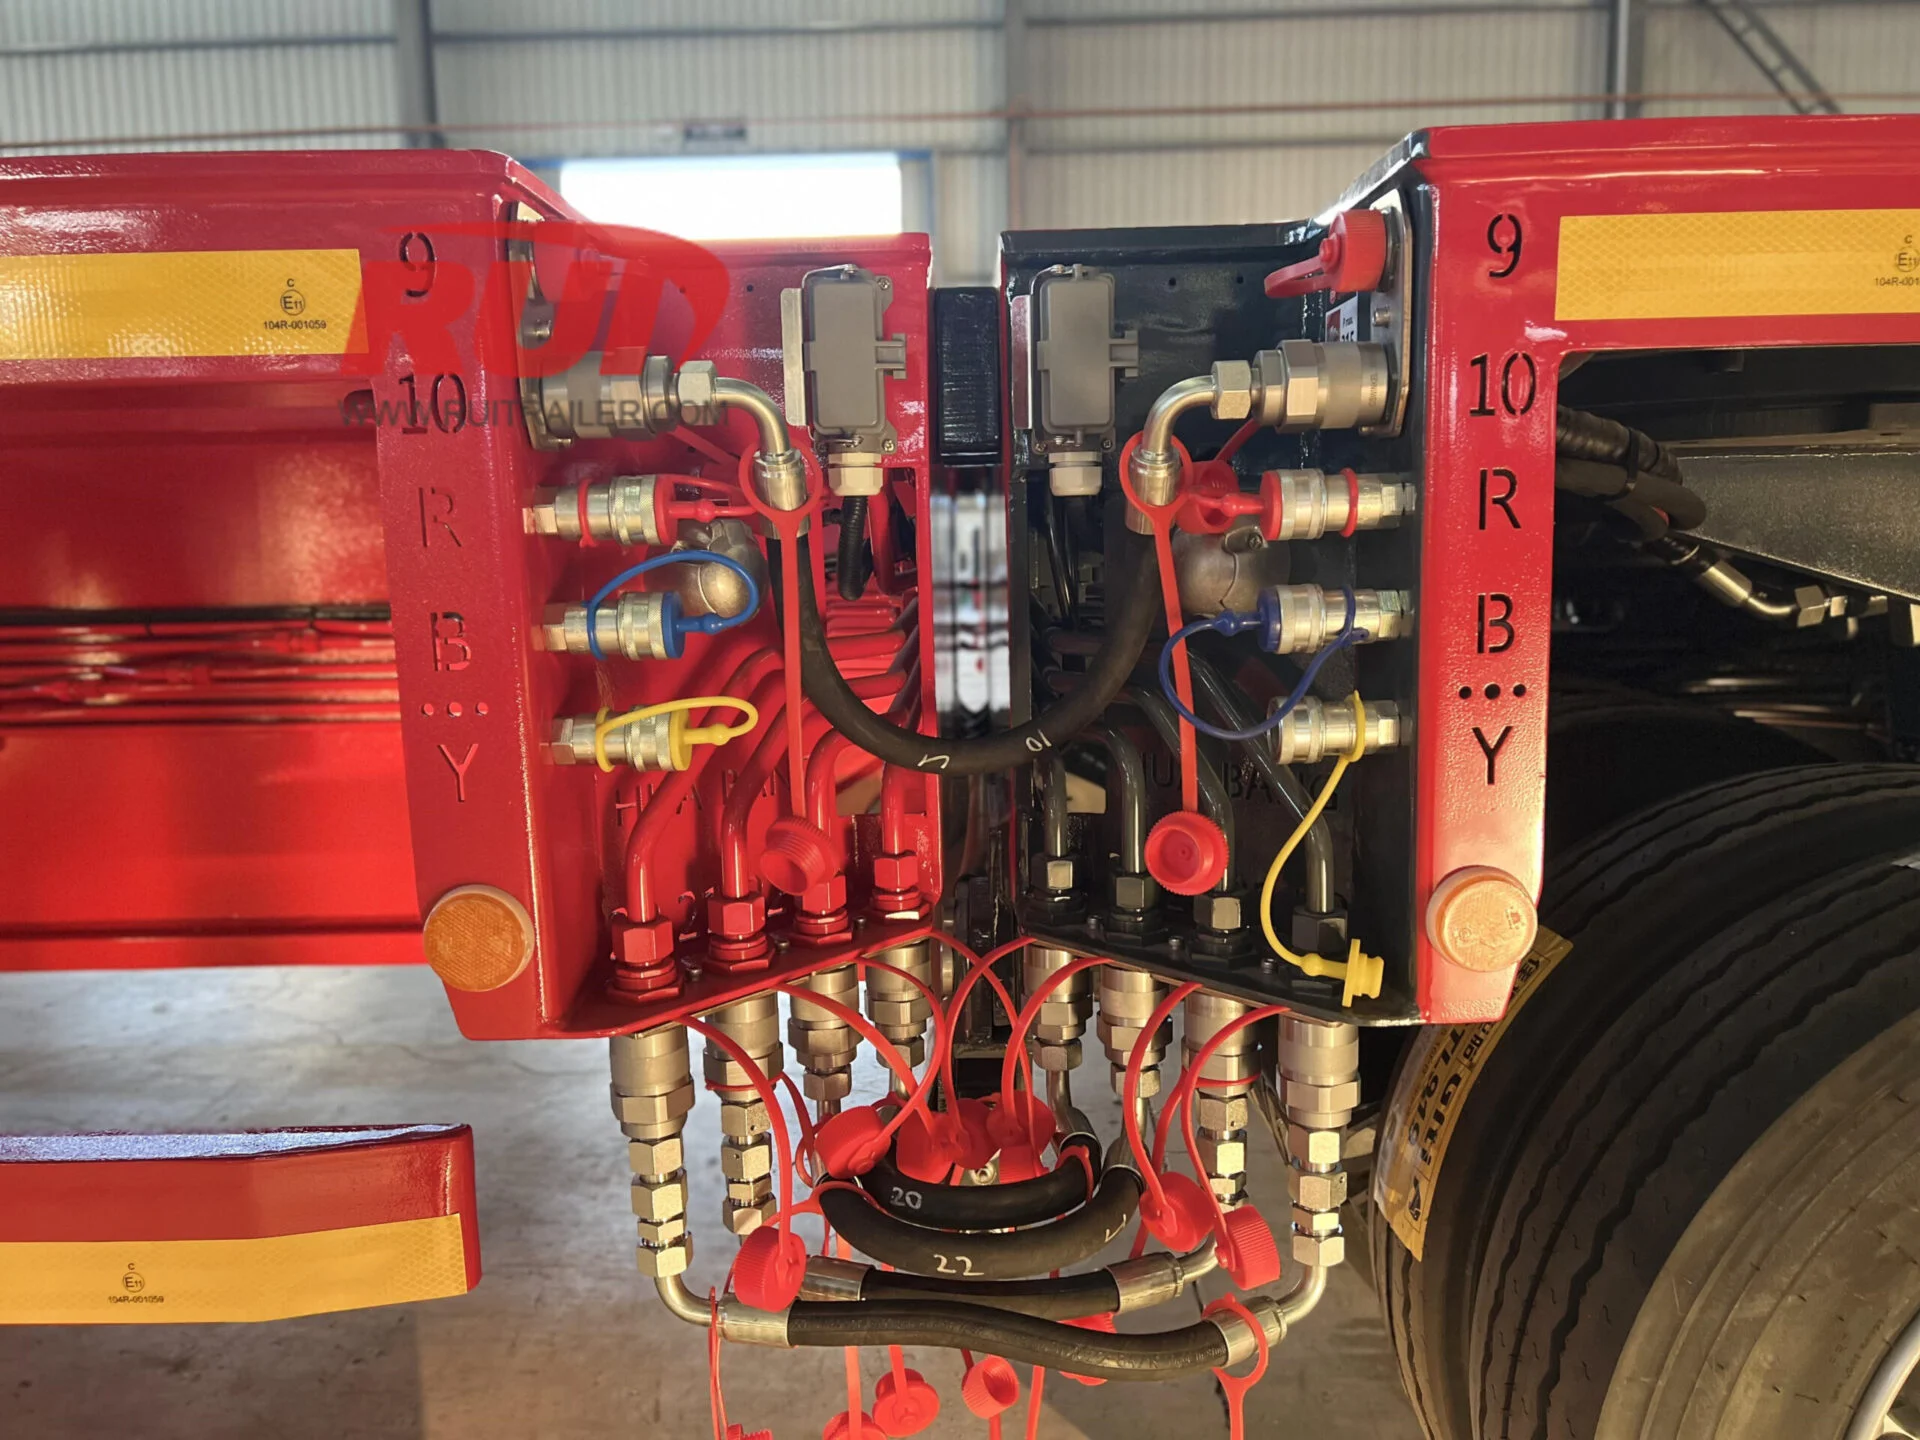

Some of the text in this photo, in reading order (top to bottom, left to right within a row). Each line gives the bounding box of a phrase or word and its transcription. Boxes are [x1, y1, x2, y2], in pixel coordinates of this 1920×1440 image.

[398, 232, 437, 297] 9
[1486, 213, 1522, 279] 9
[263, 320, 327, 330] 104R-001059
[398, 372, 467, 434] 10
[1469, 351, 1536, 417] 10
[418, 486, 462, 547] R
[1478, 467, 1522, 530] R
[430, 611, 472, 671] B
[1476, 592, 1515, 654] B
[437, 742, 479, 802] Y
[1471, 725, 1513, 786] Y
[889, 1186, 922, 1209] 20
[933, 1253, 984, 1277] 22
